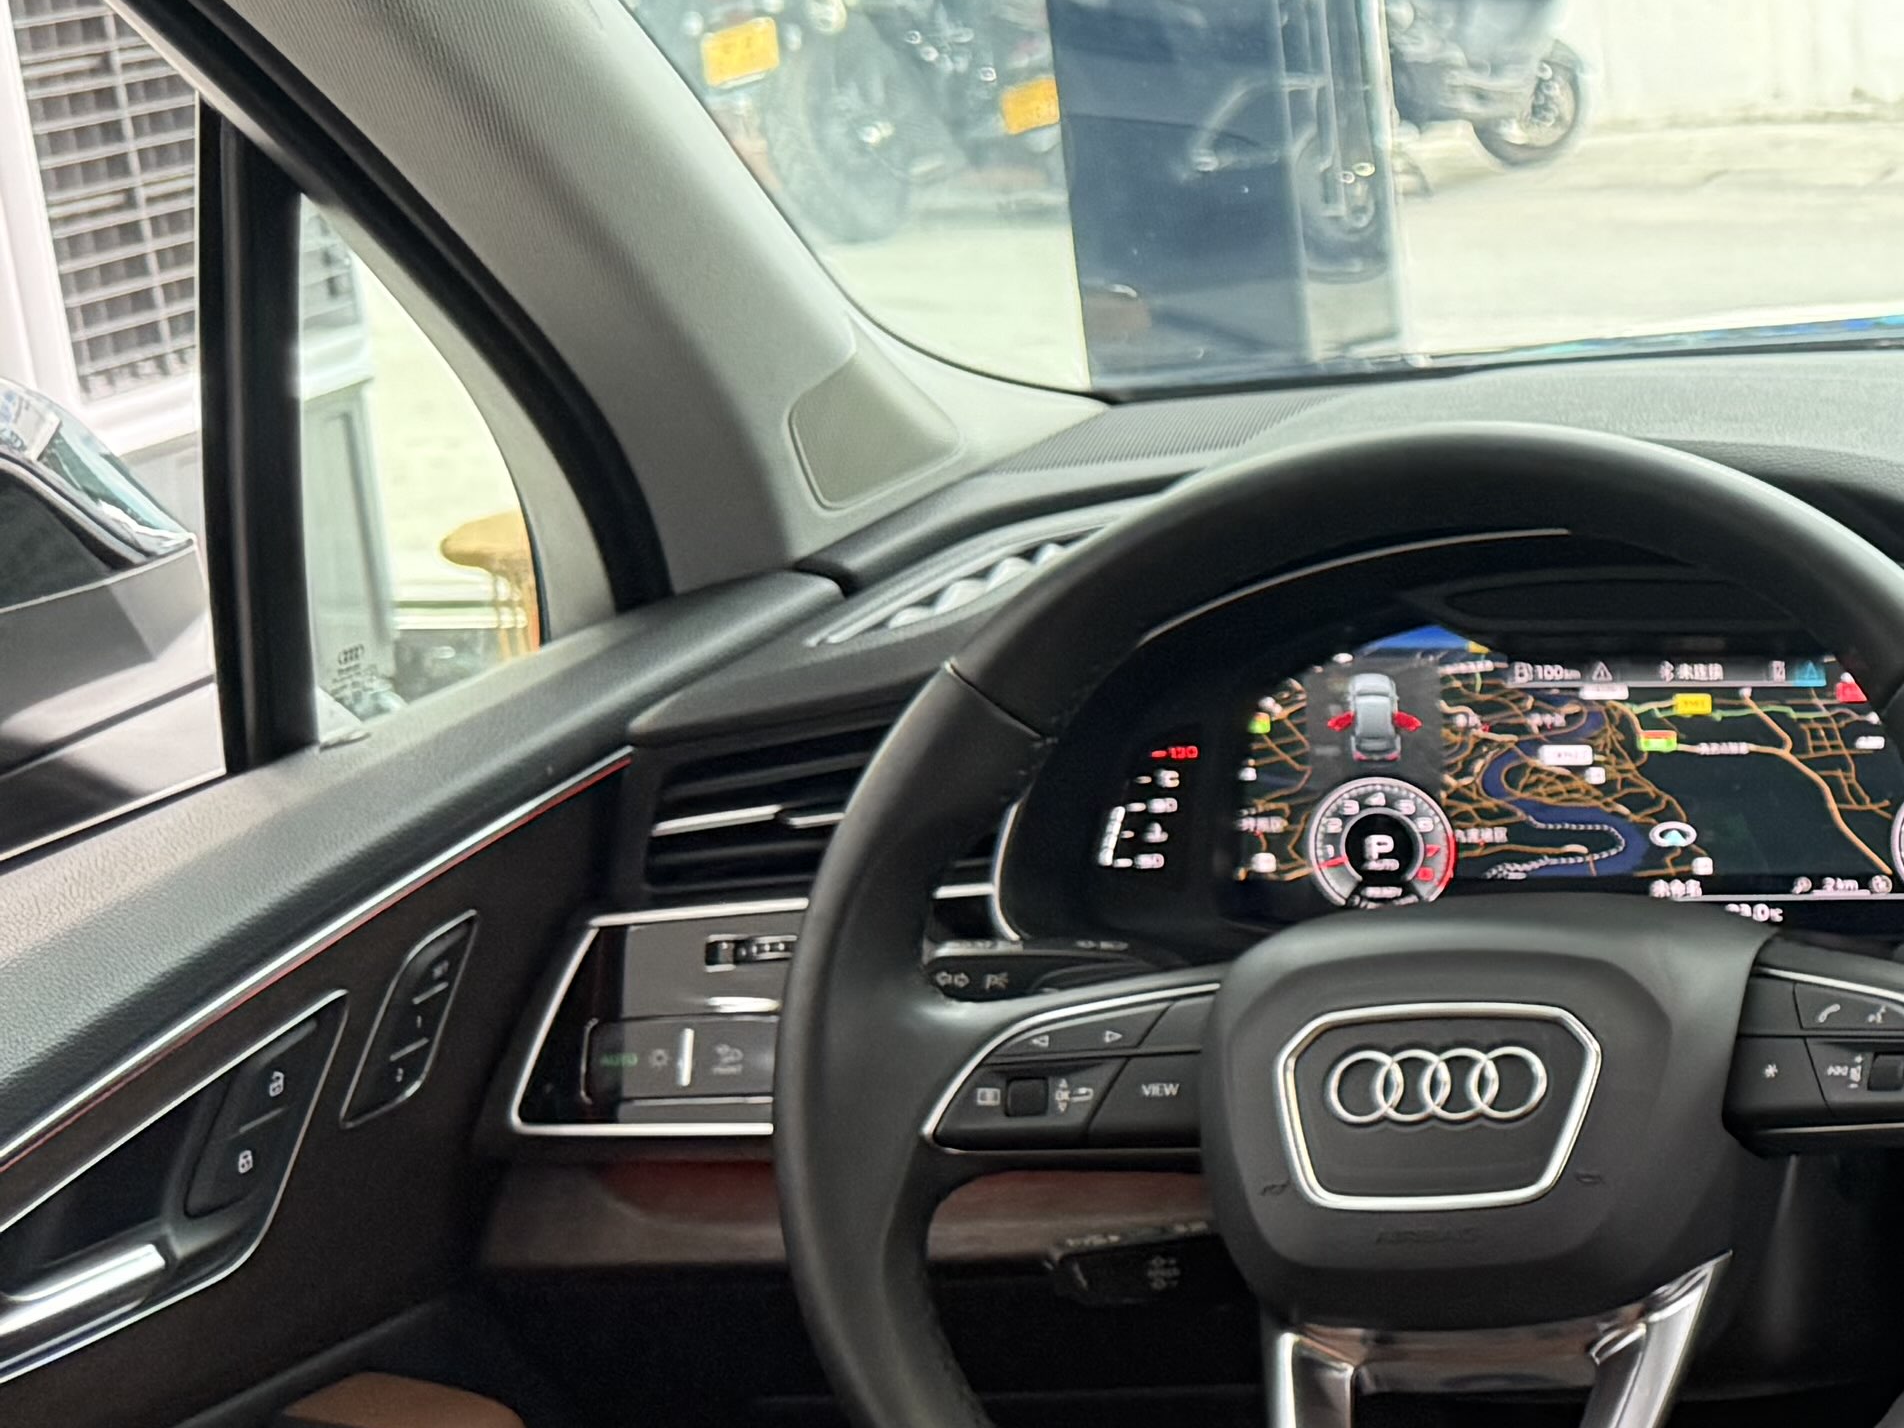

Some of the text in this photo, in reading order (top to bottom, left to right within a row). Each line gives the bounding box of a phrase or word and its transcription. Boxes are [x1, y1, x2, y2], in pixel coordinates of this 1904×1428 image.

[1343, 799, 1360, 815] 3
[1365, 793, 1386, 807] 4
[1326, 818, 1343, 833] 2
[1364, 834, 1395, 860] P
[1141, 1083, 1180, 1097] VIEW
